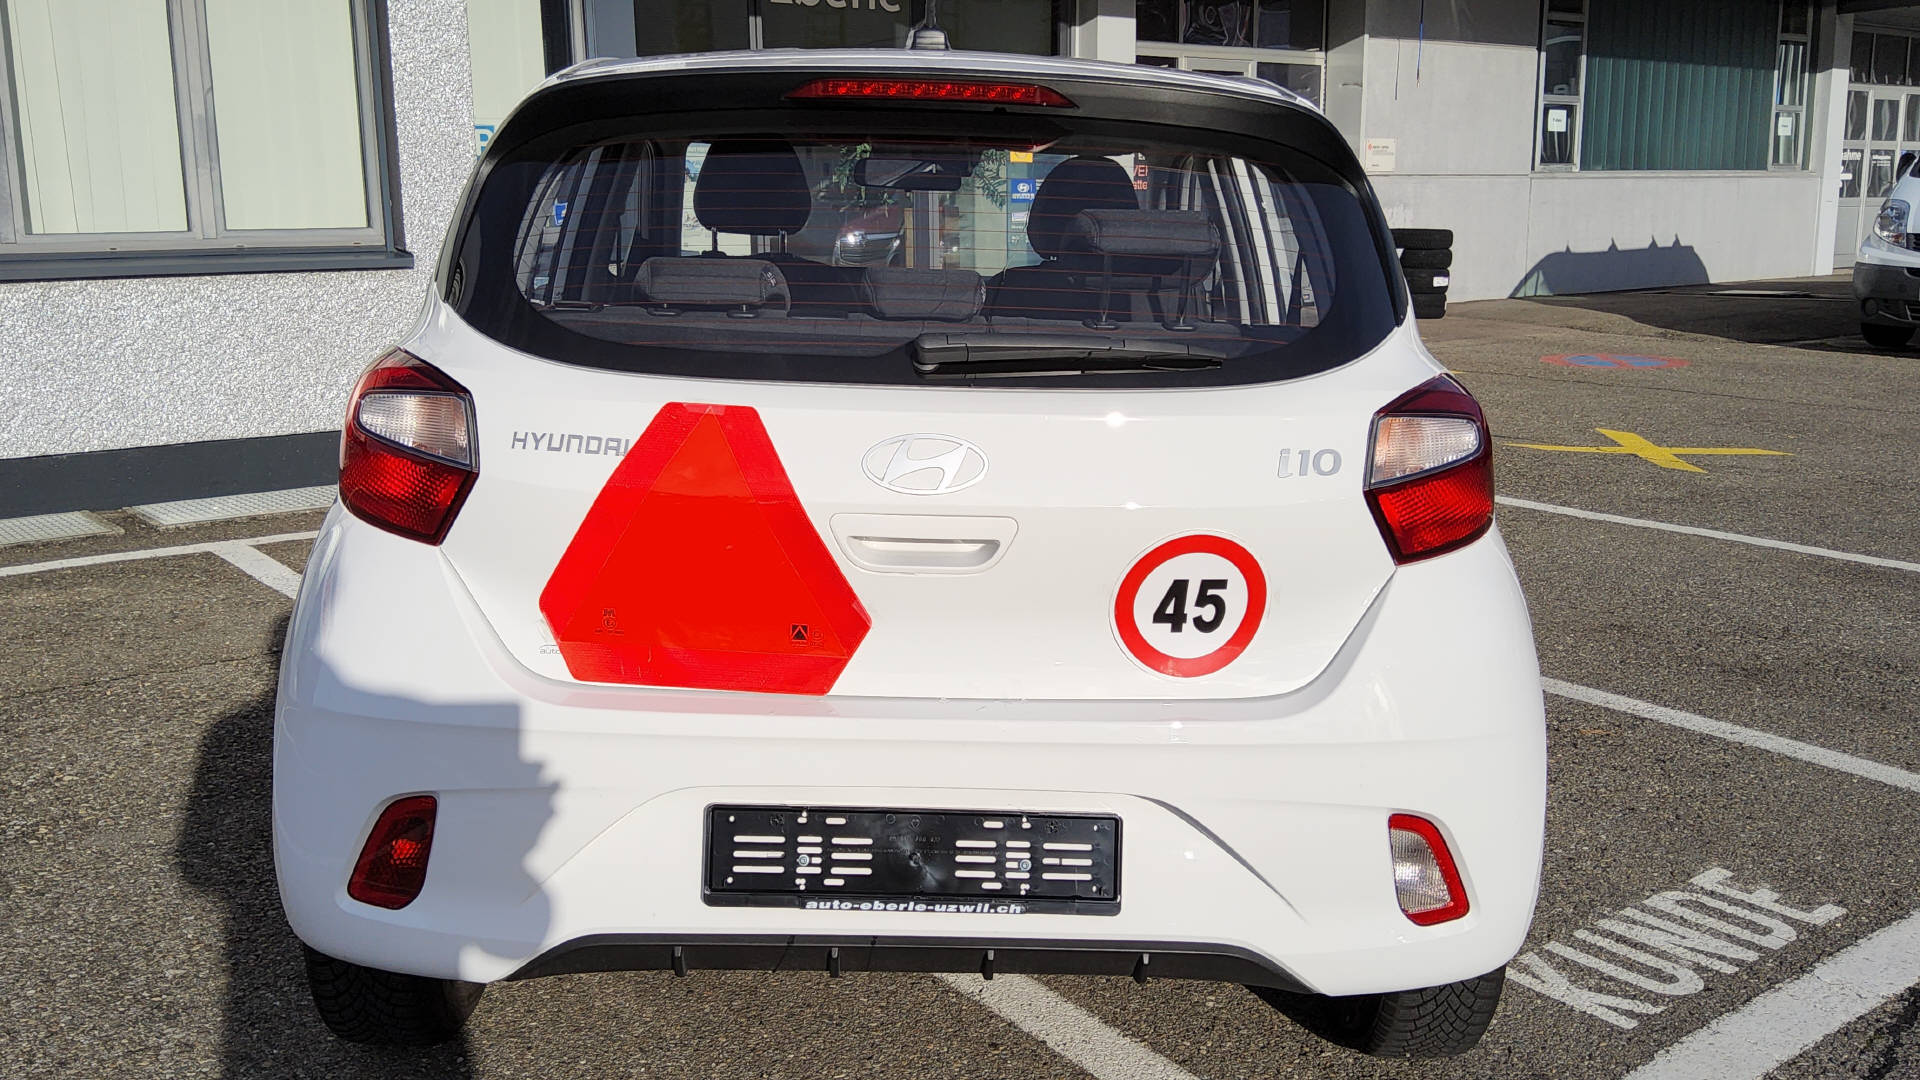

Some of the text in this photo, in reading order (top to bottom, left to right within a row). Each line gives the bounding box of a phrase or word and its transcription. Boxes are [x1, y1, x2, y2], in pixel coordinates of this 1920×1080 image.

[511, 431, 630, 457] HYUNDAI
[1277, 448, 1342, 478] i10
[1152, 579, 1228, 633] 45
[805, 900, 1022, 914] auto-eberle-uzwil.ch
[1505, 867, 1847, 1029] KUNDE
